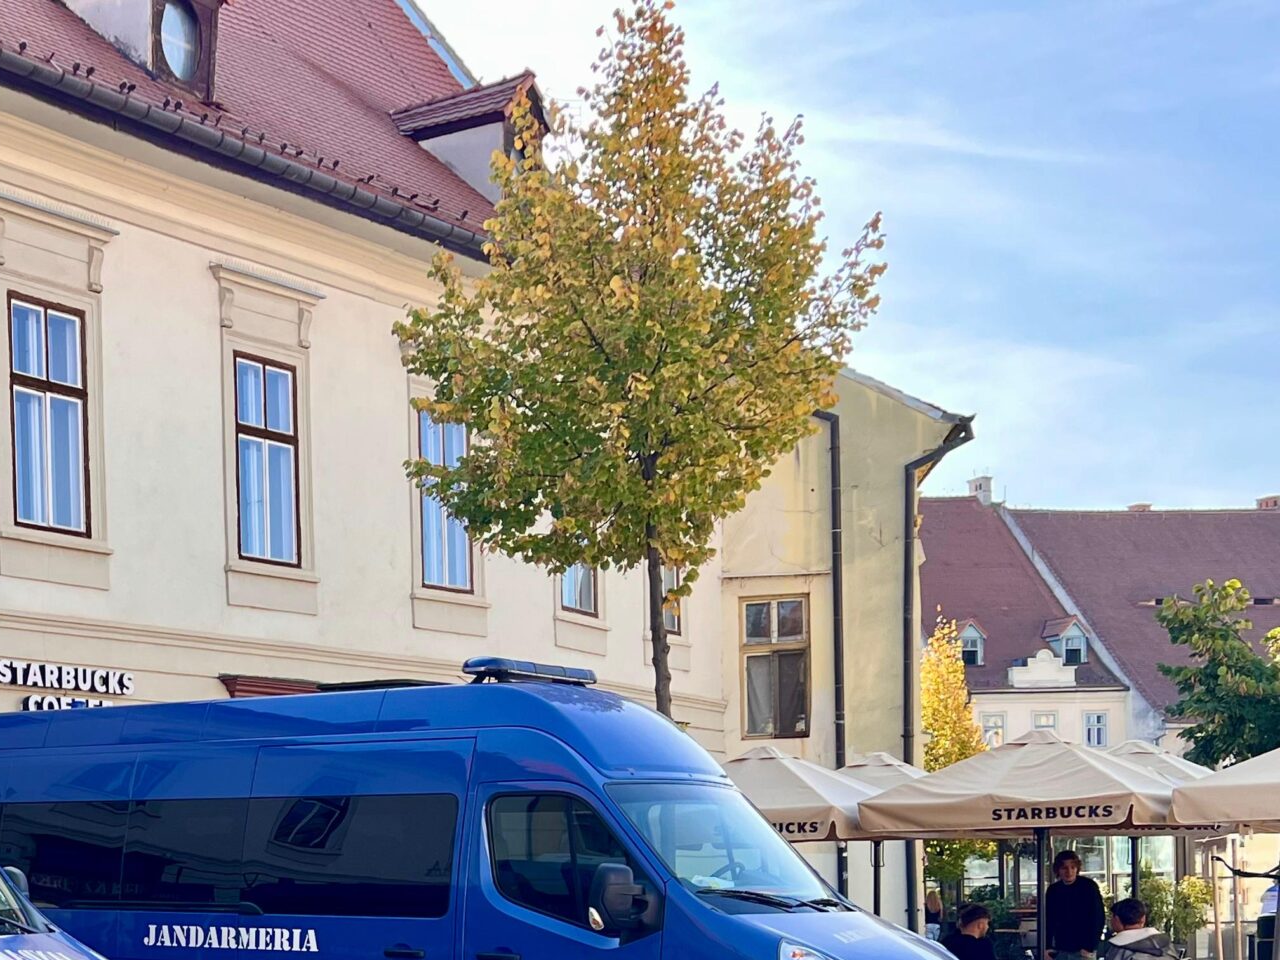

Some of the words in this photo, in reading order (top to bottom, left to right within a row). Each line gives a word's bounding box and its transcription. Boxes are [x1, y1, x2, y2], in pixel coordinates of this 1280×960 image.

[28, 694, 115, 712] COF
[991, 804, 1114, 822] STARBUCKS
[143, 924, 320, 952] JANDARMERIA
